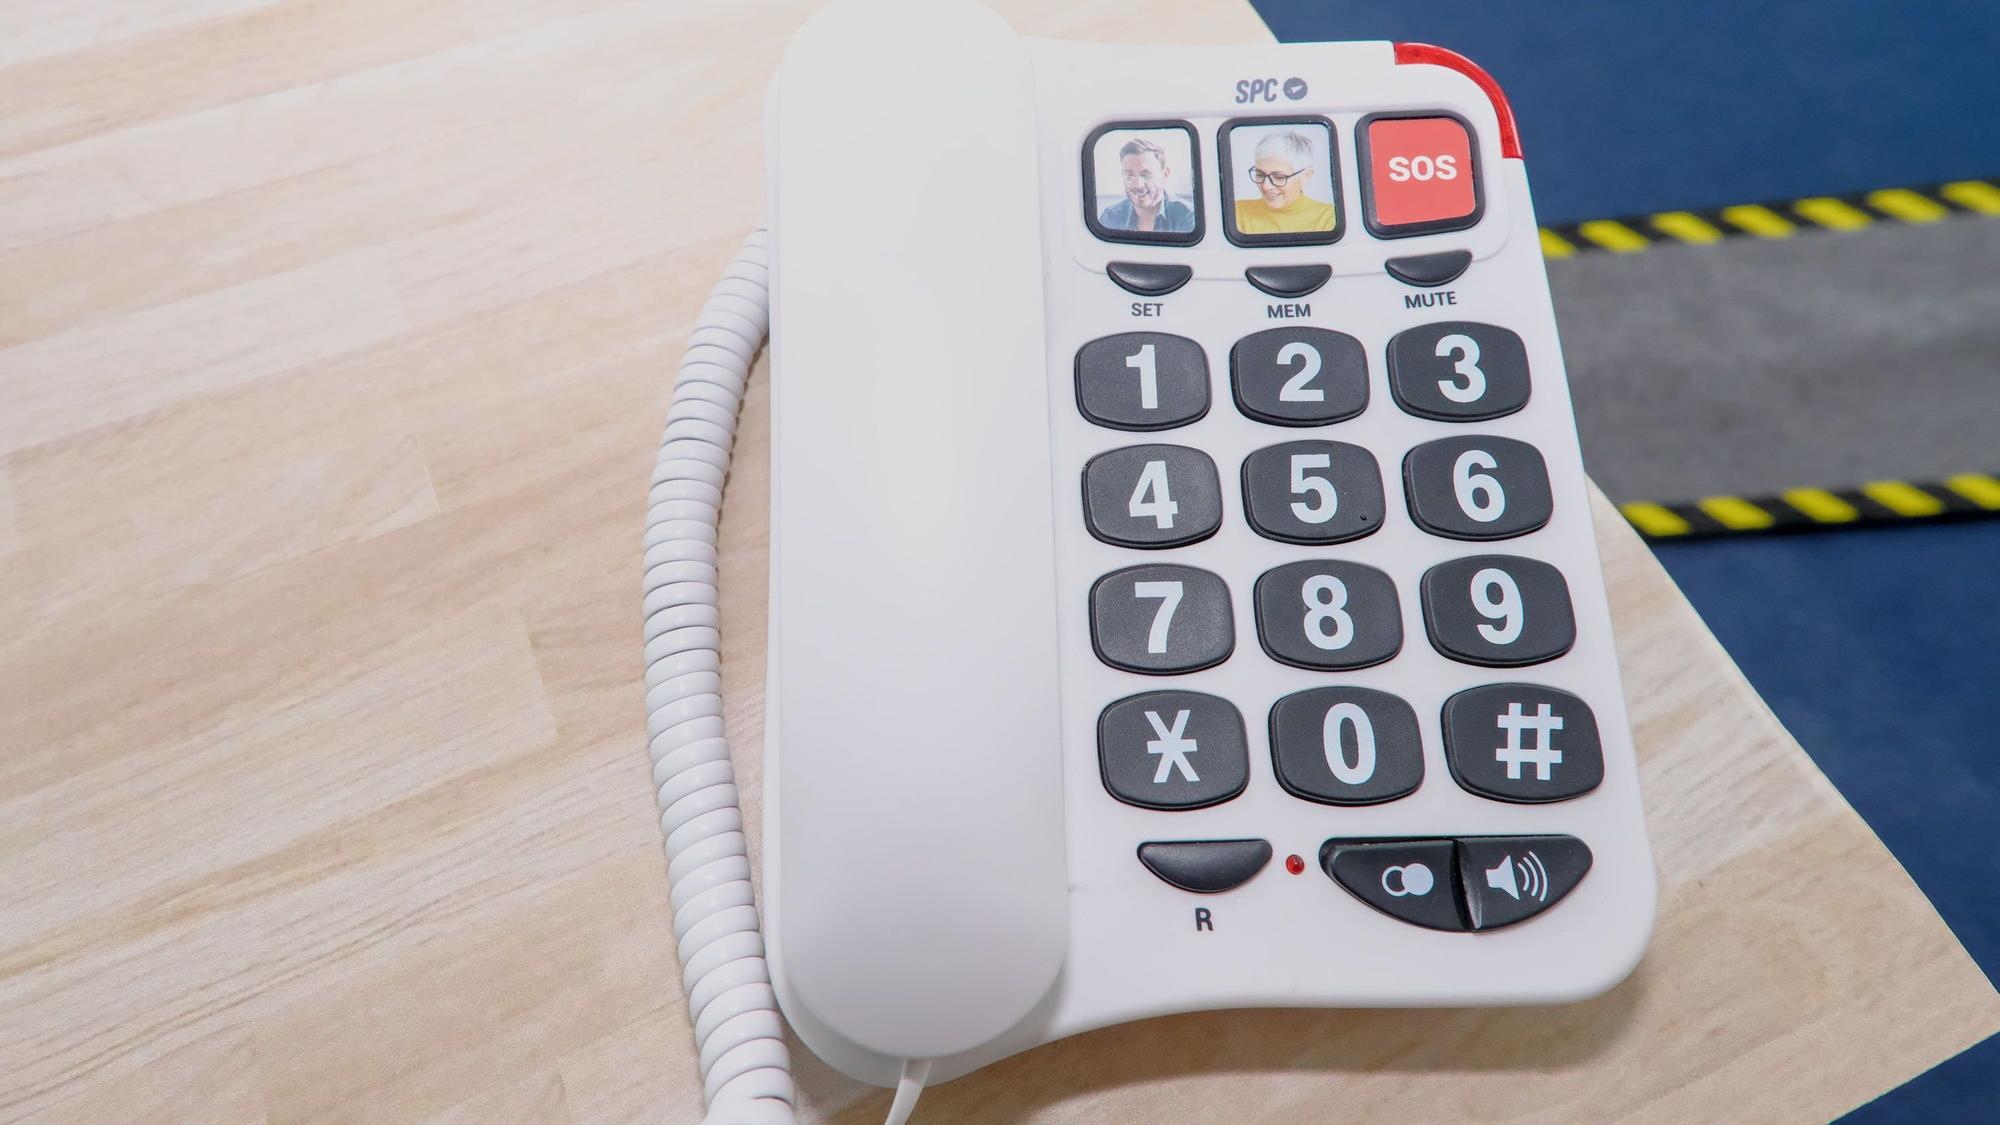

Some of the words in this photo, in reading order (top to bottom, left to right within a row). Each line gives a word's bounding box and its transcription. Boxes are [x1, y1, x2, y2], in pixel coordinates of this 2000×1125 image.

[1235, 78, 1278, 104] SPC
[1388, 154, 1458, 182] SOS
[1130, 302, 1164, 317] SET
[1267, 303, 1311, 319] MEM
[1404, 290, 1458, 309] MUTE
[1125, 343, 1158, 409] 1
[1276, 342, 1325, 402] 2
[1434, 334, 1486, 403] 3
[1128, 460, 1179, 529] 4
[1290, 453, 1338, 524] 5
[1452, 449, 1506, 523] 6
[1134, 580, 1184, 654] 7
[1301, 574, 1354, 651] 8
[1469, 568, 1525, 645] 9
[1322, 702, 1376, 785] 0
[1194, 907, 1214, 932] R
